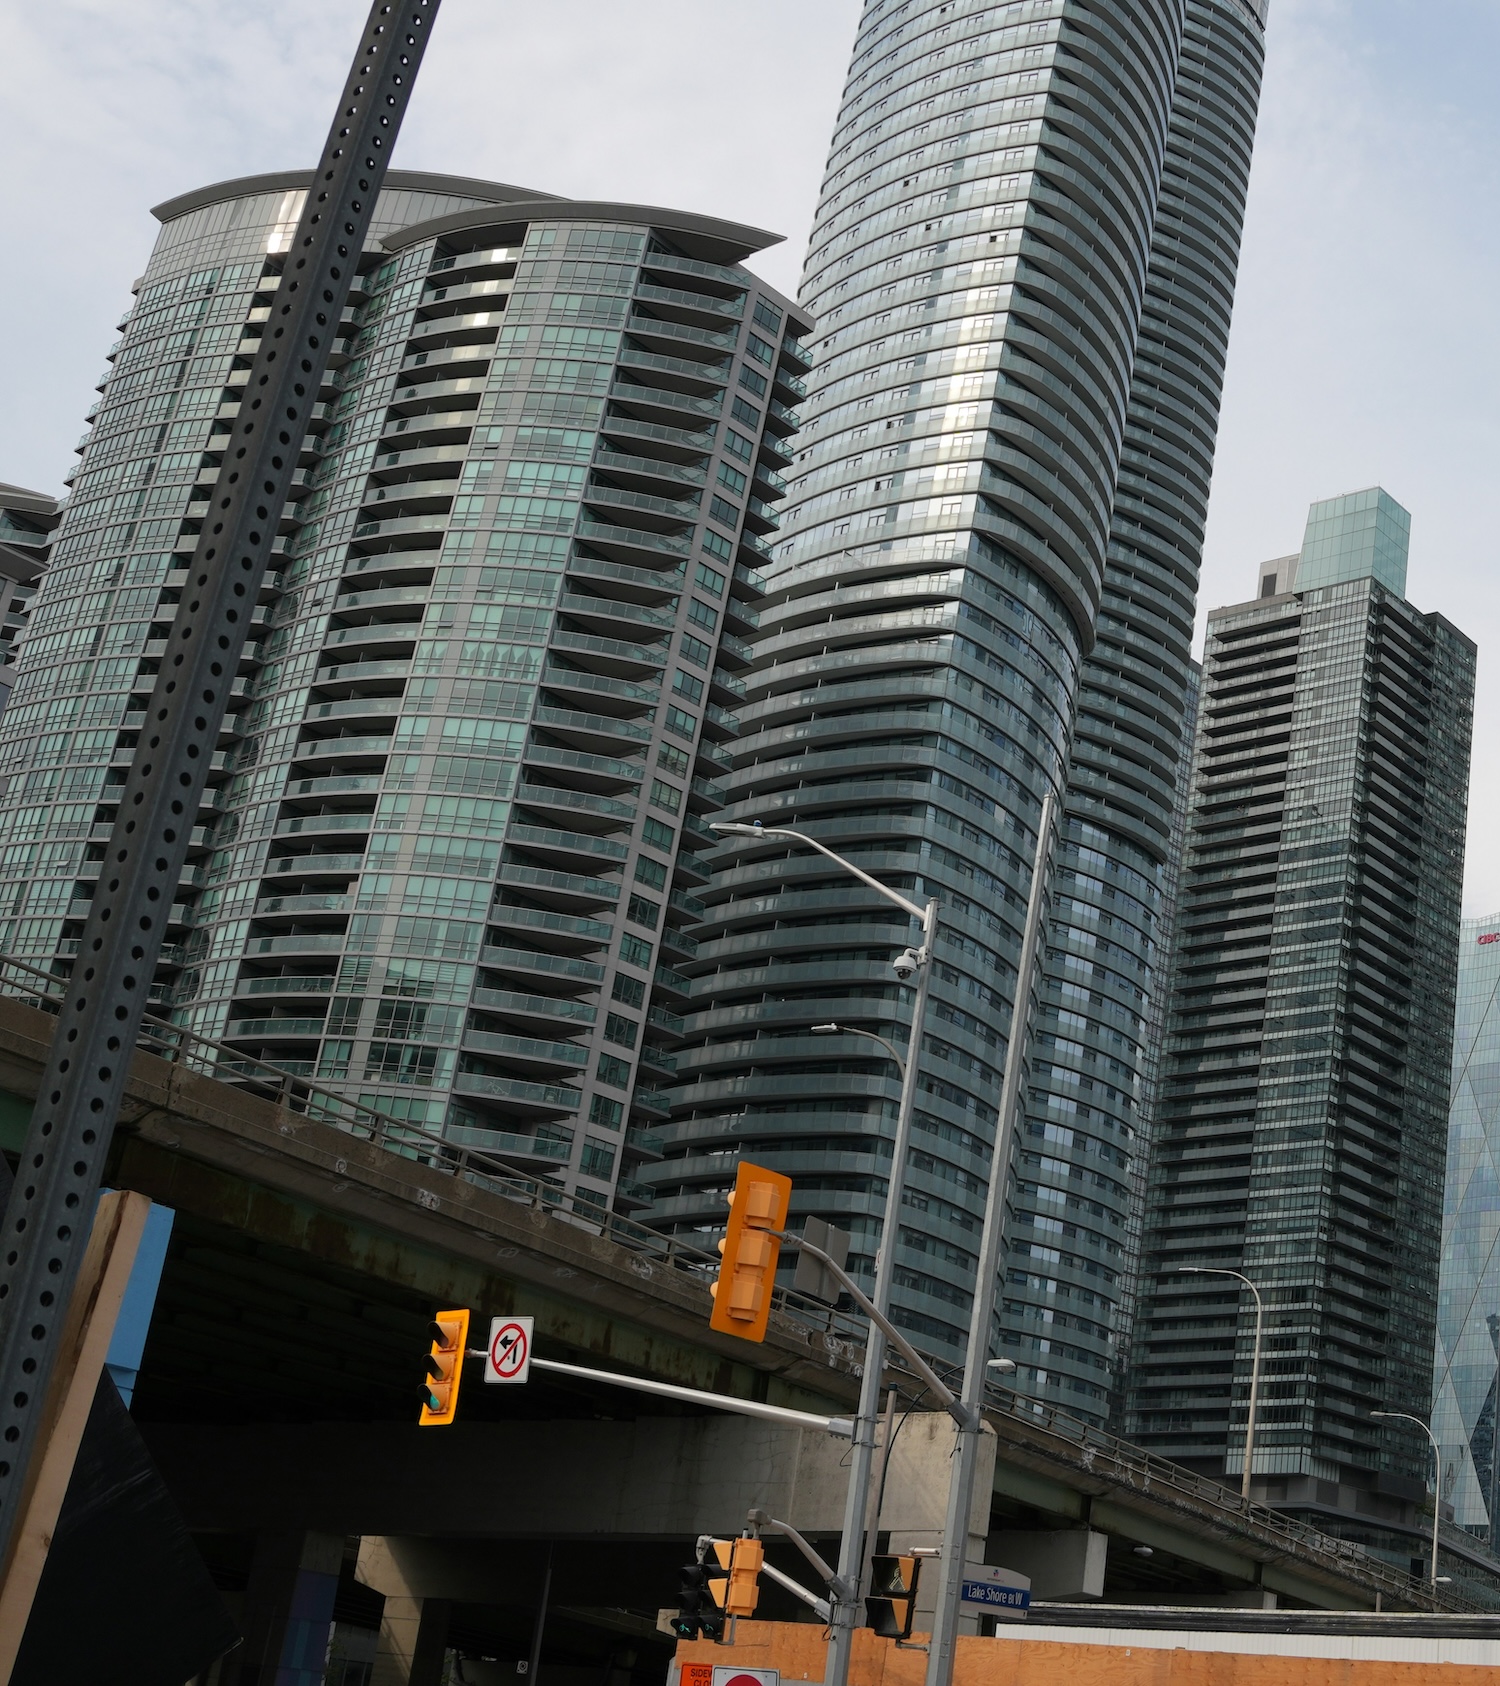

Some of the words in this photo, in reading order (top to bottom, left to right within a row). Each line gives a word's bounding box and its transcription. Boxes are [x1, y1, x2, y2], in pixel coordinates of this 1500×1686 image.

[967, 1584, 986, 1600] Lake
[985, 1587, 1008, 1604] Shore
[1015, 1592, 1023, 1606] W
